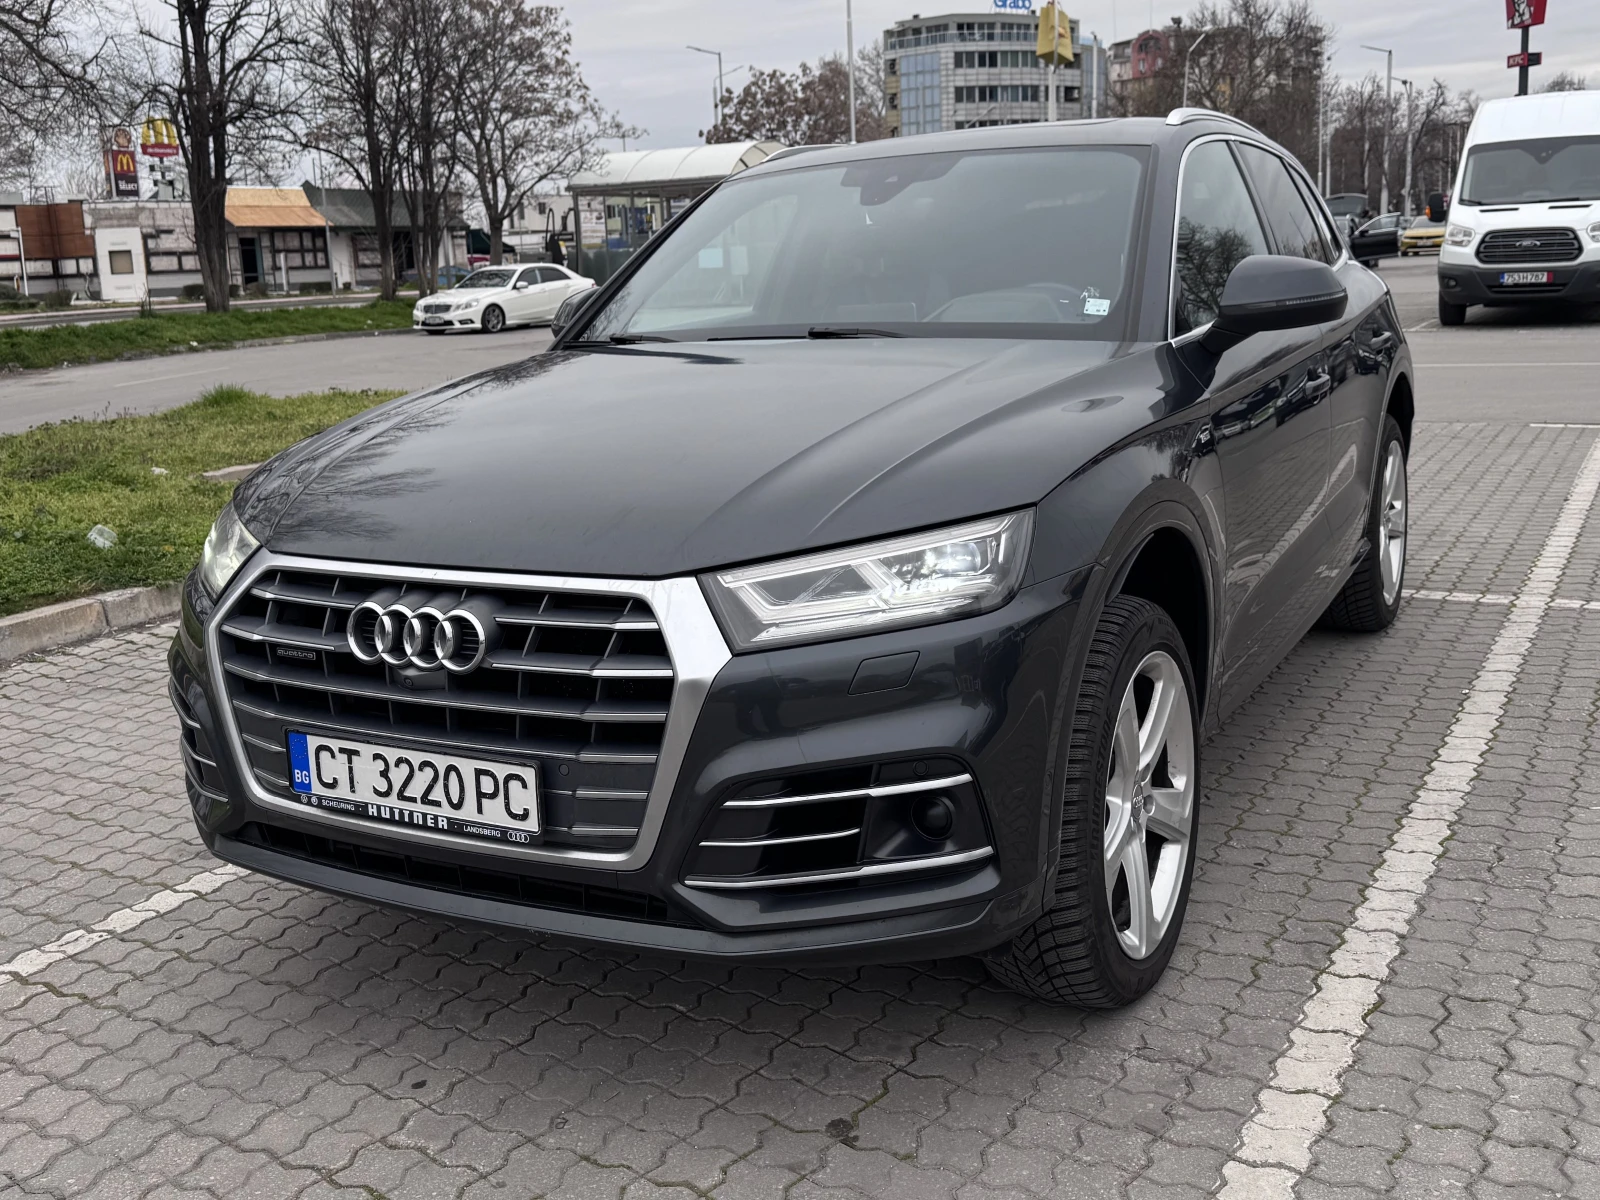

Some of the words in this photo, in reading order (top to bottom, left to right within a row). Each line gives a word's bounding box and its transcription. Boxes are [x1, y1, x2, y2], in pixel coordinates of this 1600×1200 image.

[1508, 54, 1524, 66] KFC
[277, 649, 314, 659] quattro
[294, 769, 310, 784] BG
[313, 744, 361, 794] CT
[372, 752, 466, 811] 3220
[474, 767, 530, 822] PC
[321, 799, 355, 811] SCHEURING
[367, 803, 448, 830] HUTTNER
[463, 825, 501, 837] LANDSBERG
